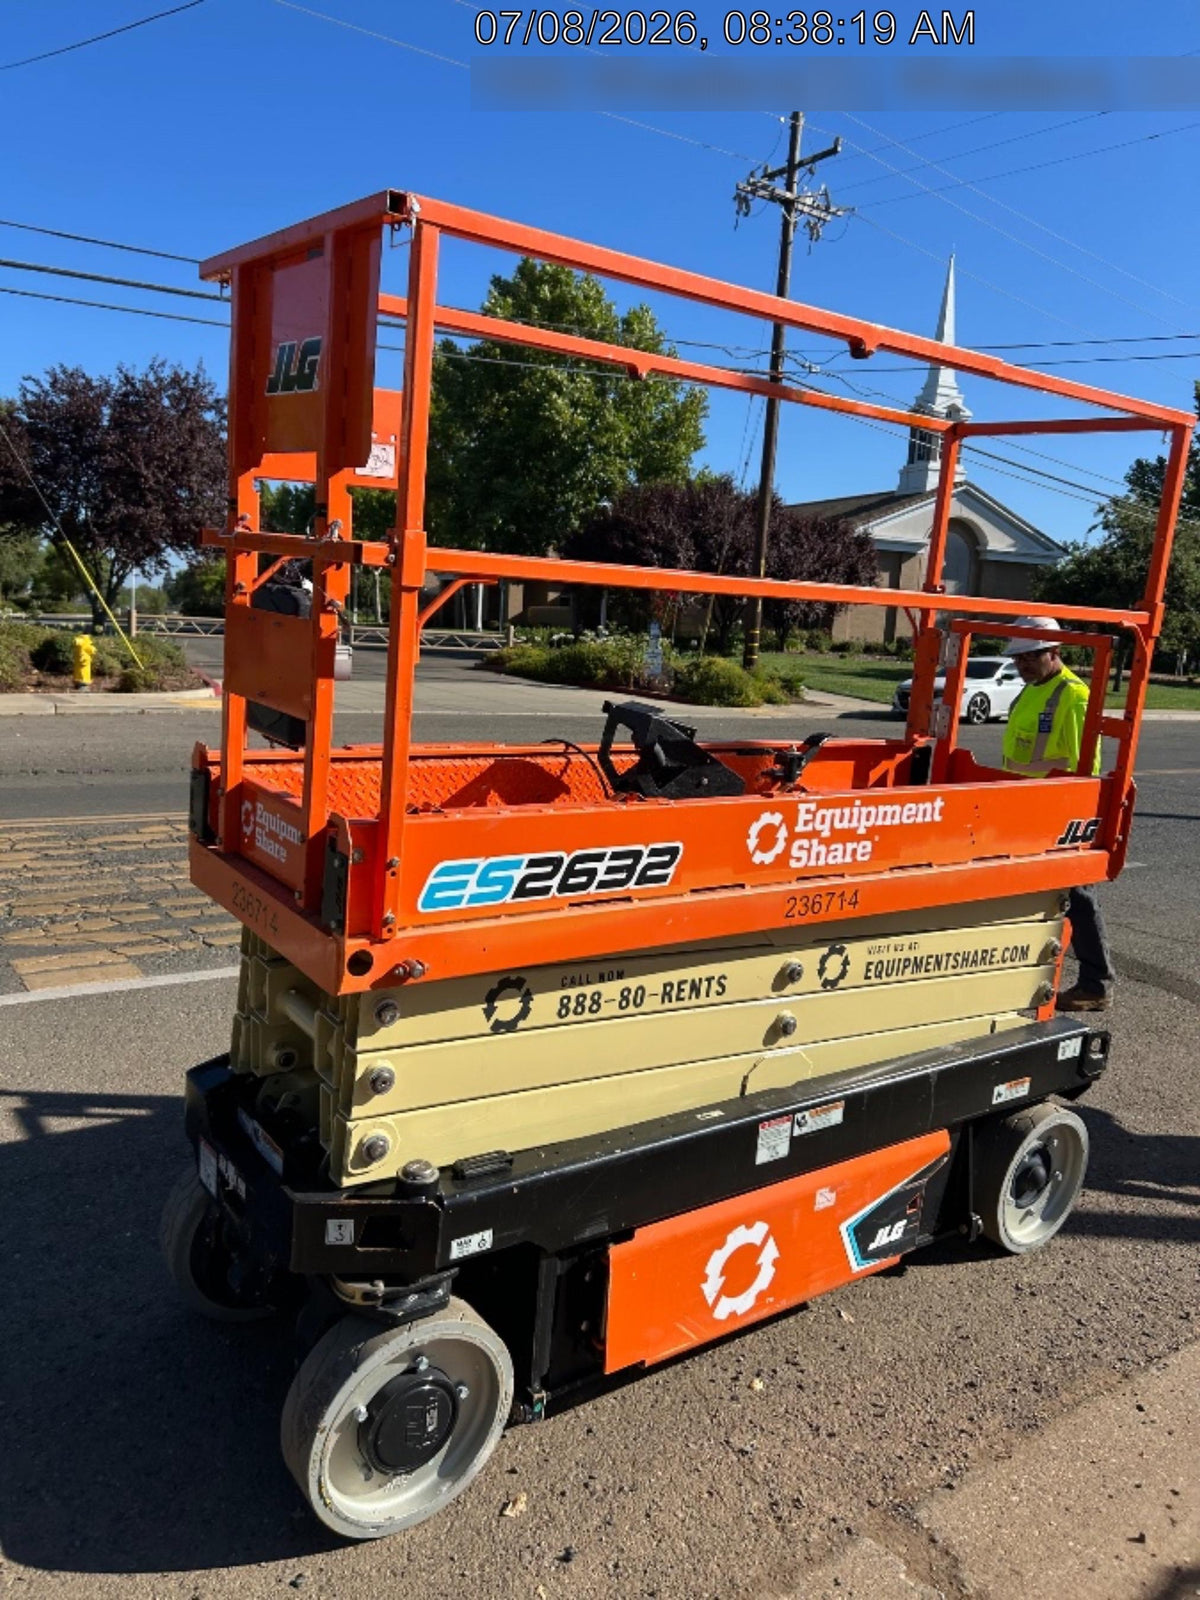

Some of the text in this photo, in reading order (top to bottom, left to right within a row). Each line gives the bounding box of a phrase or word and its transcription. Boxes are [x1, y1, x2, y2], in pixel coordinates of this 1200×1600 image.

[265, 336, 321, 396] JLG
[795, 796, 944, 834] Equipment
[1056, 818, 1102, 847] JLG
[256, 826, 287, 863] Share
[790, 838, 872, 868] Share
[418, 842, 683, 912] ES2632
[785, 889, 860, 919] 236714
[561, 969, 625, 988] CALL NOW
[864, 944, 1030, 980] EQUIPMENTSHARE.COM
[557, 974, 728, 1019] 888-80-RENTS
[867, 1219, 908, 1251] JLG
